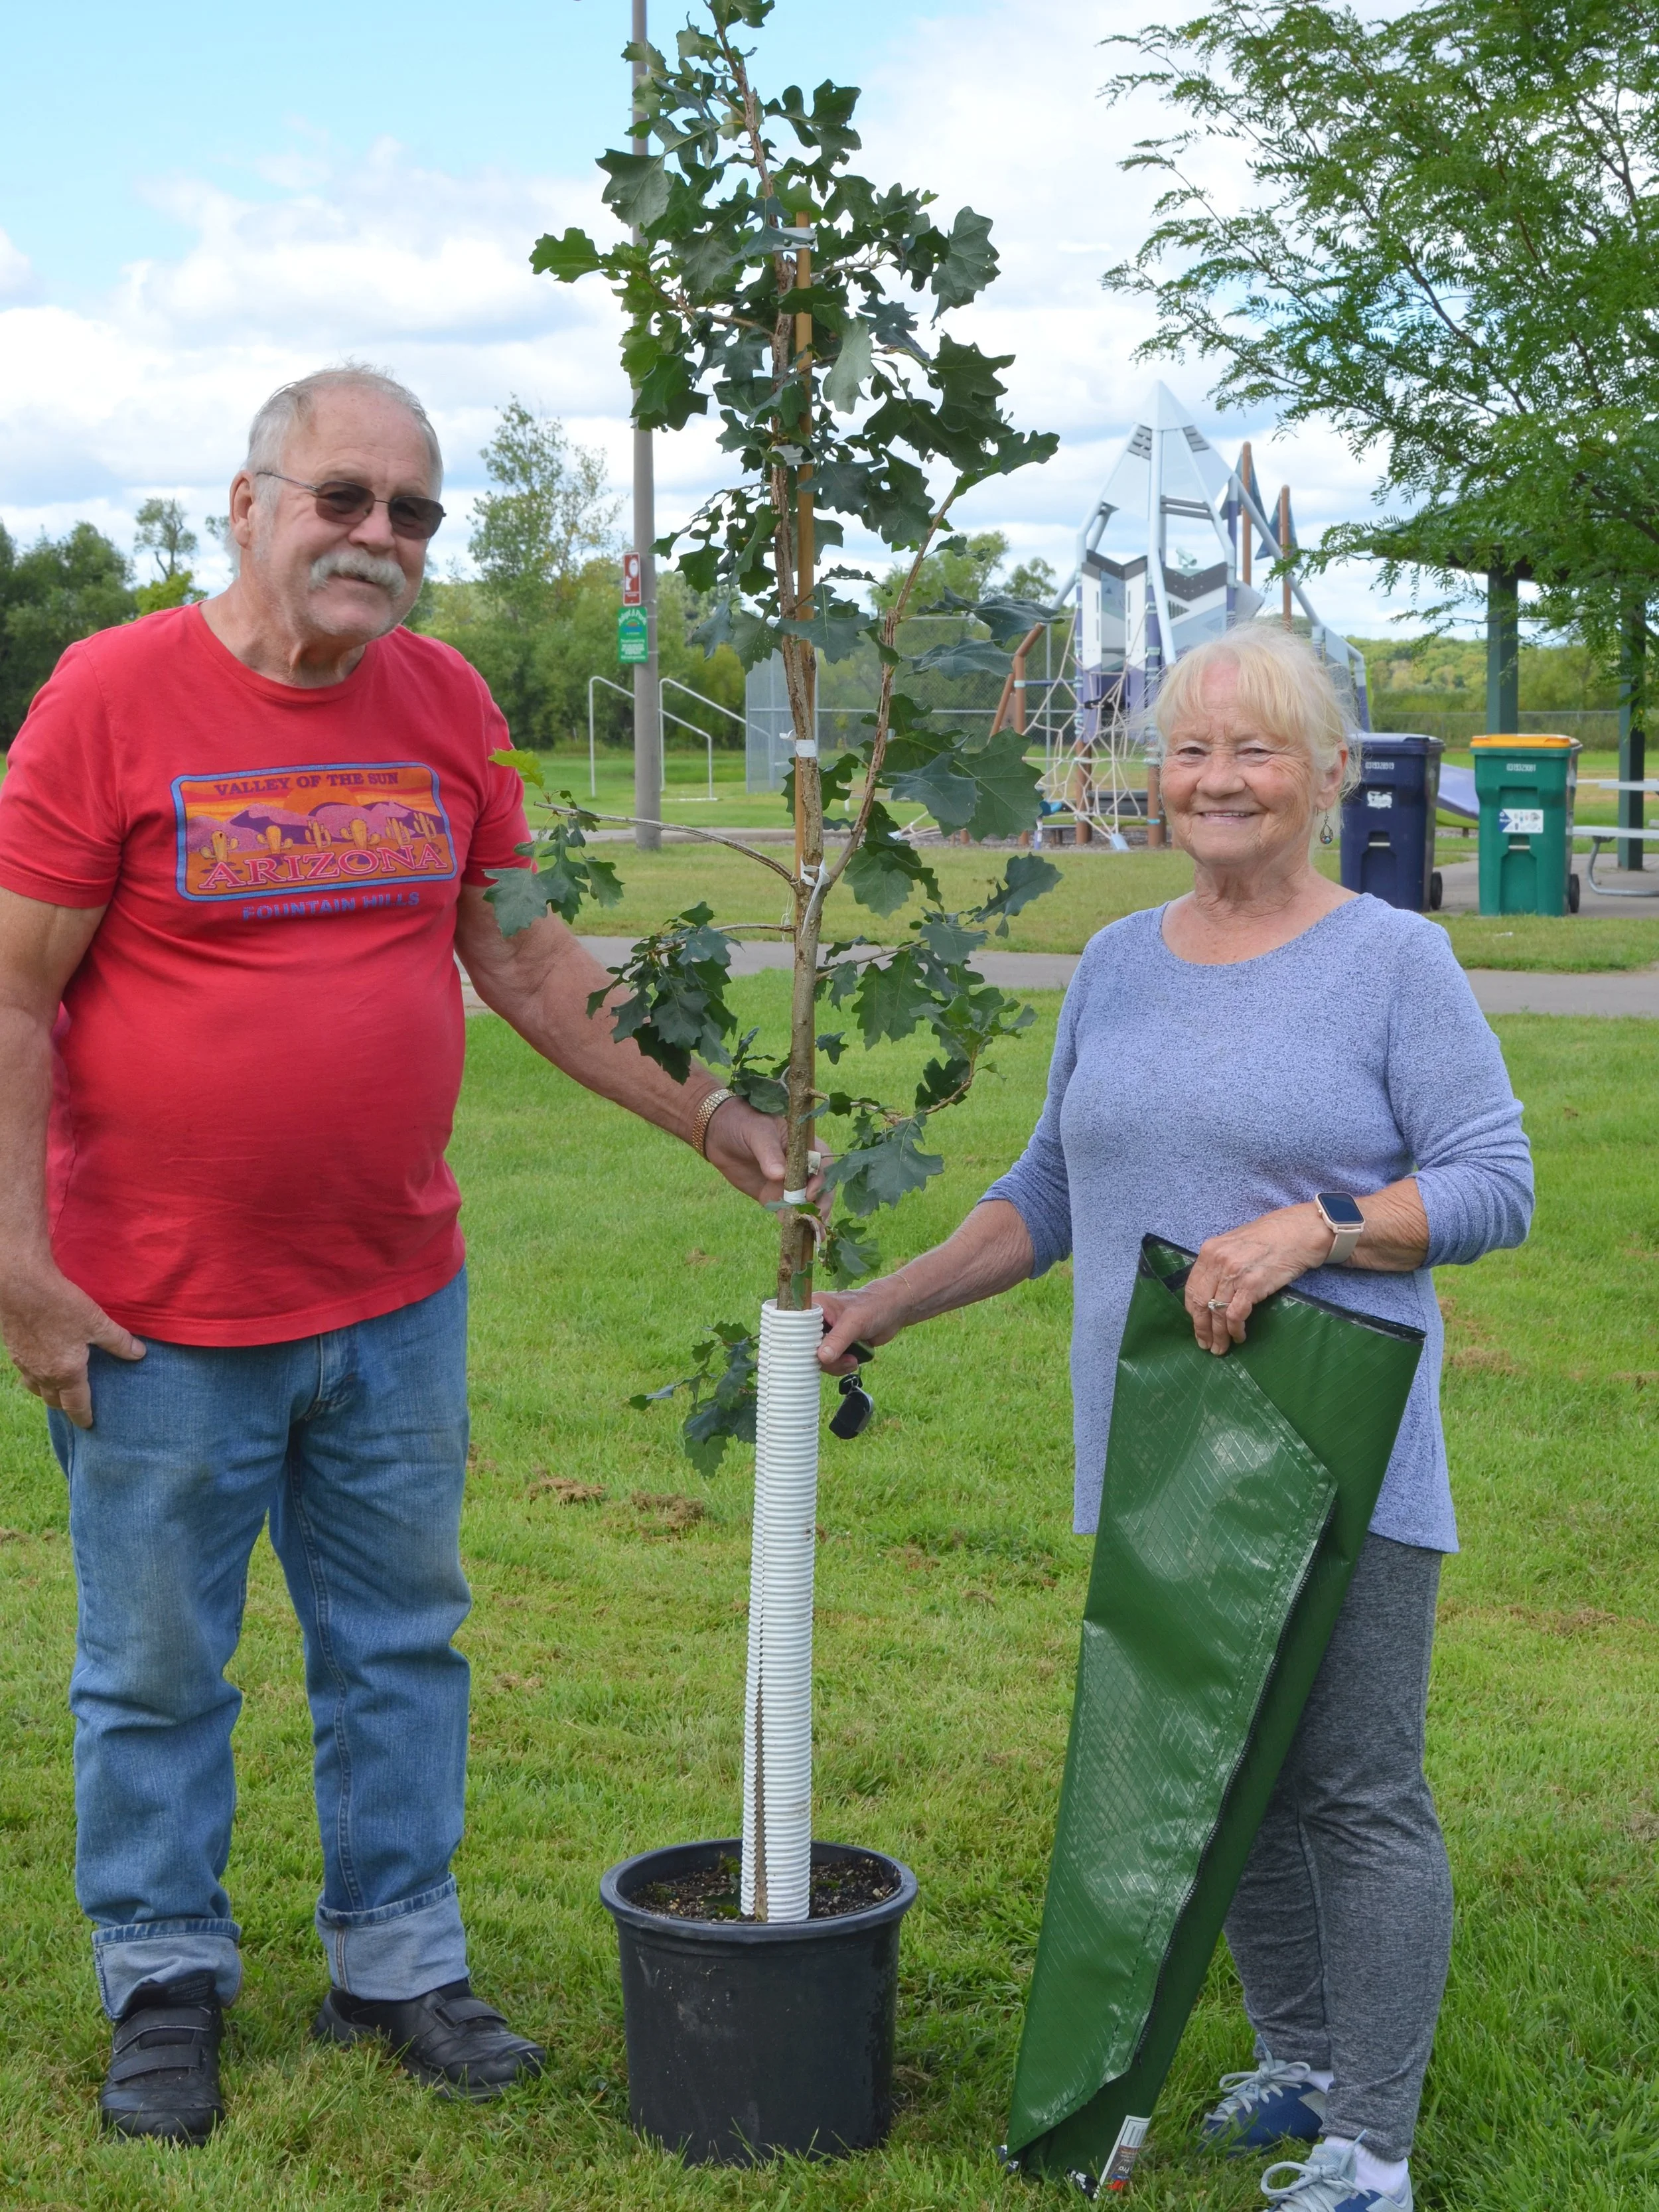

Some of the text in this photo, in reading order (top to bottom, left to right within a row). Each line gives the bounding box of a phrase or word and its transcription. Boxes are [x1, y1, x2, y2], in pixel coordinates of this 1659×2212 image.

[214, 772, 398, 796] VALLEY OF THE SUN
[199, 844, 447, 889] ARIZONA
[243, 892, 420, 921] FOUNTAIN HILLS
